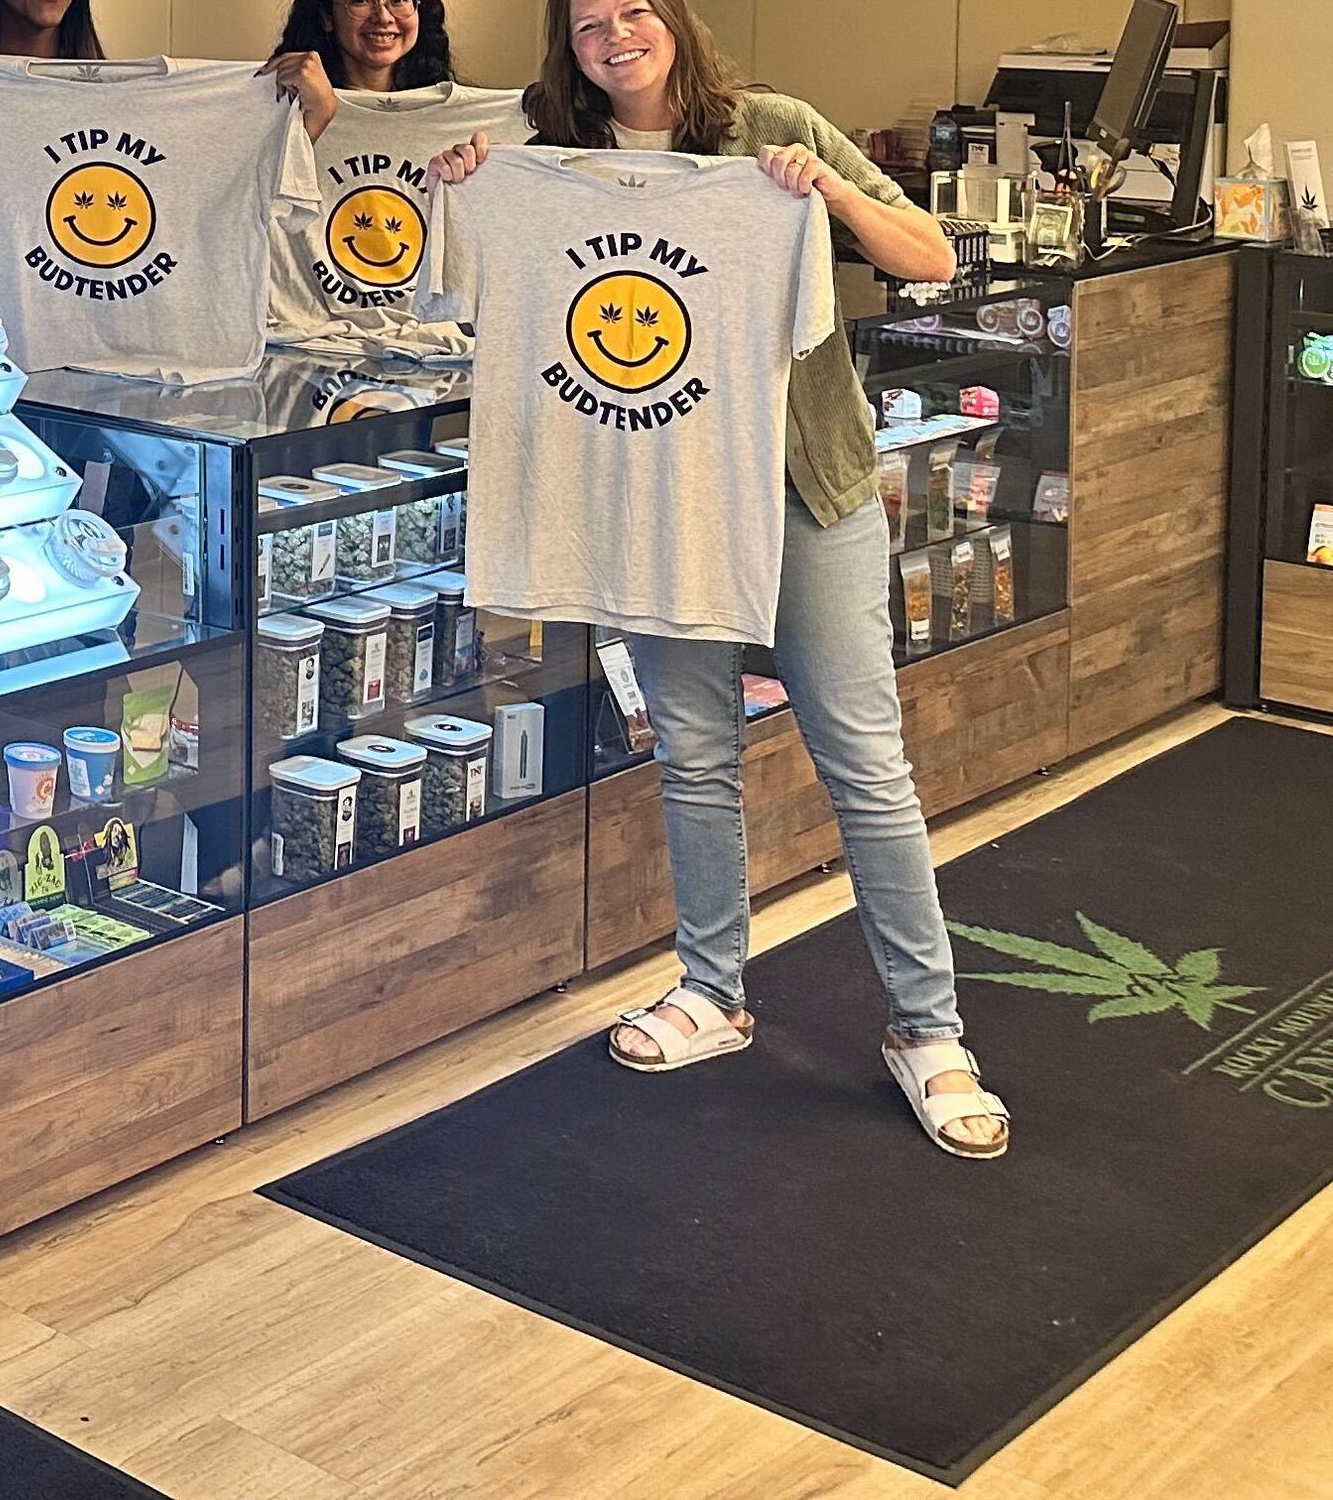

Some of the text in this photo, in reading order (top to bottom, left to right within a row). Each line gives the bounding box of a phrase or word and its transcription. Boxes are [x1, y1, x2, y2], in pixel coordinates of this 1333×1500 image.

[43, 128, 167, 167] I TIP MY
[327, 154, 429, 195] I TIP M
[24, 245, 179, 301] BUDTENDER
[565, 232, 710, 279] I TIP MY
[540, 361, 711, 432] BUDTENDER
[1213, 1035, 1286, 1078] ROCKY
